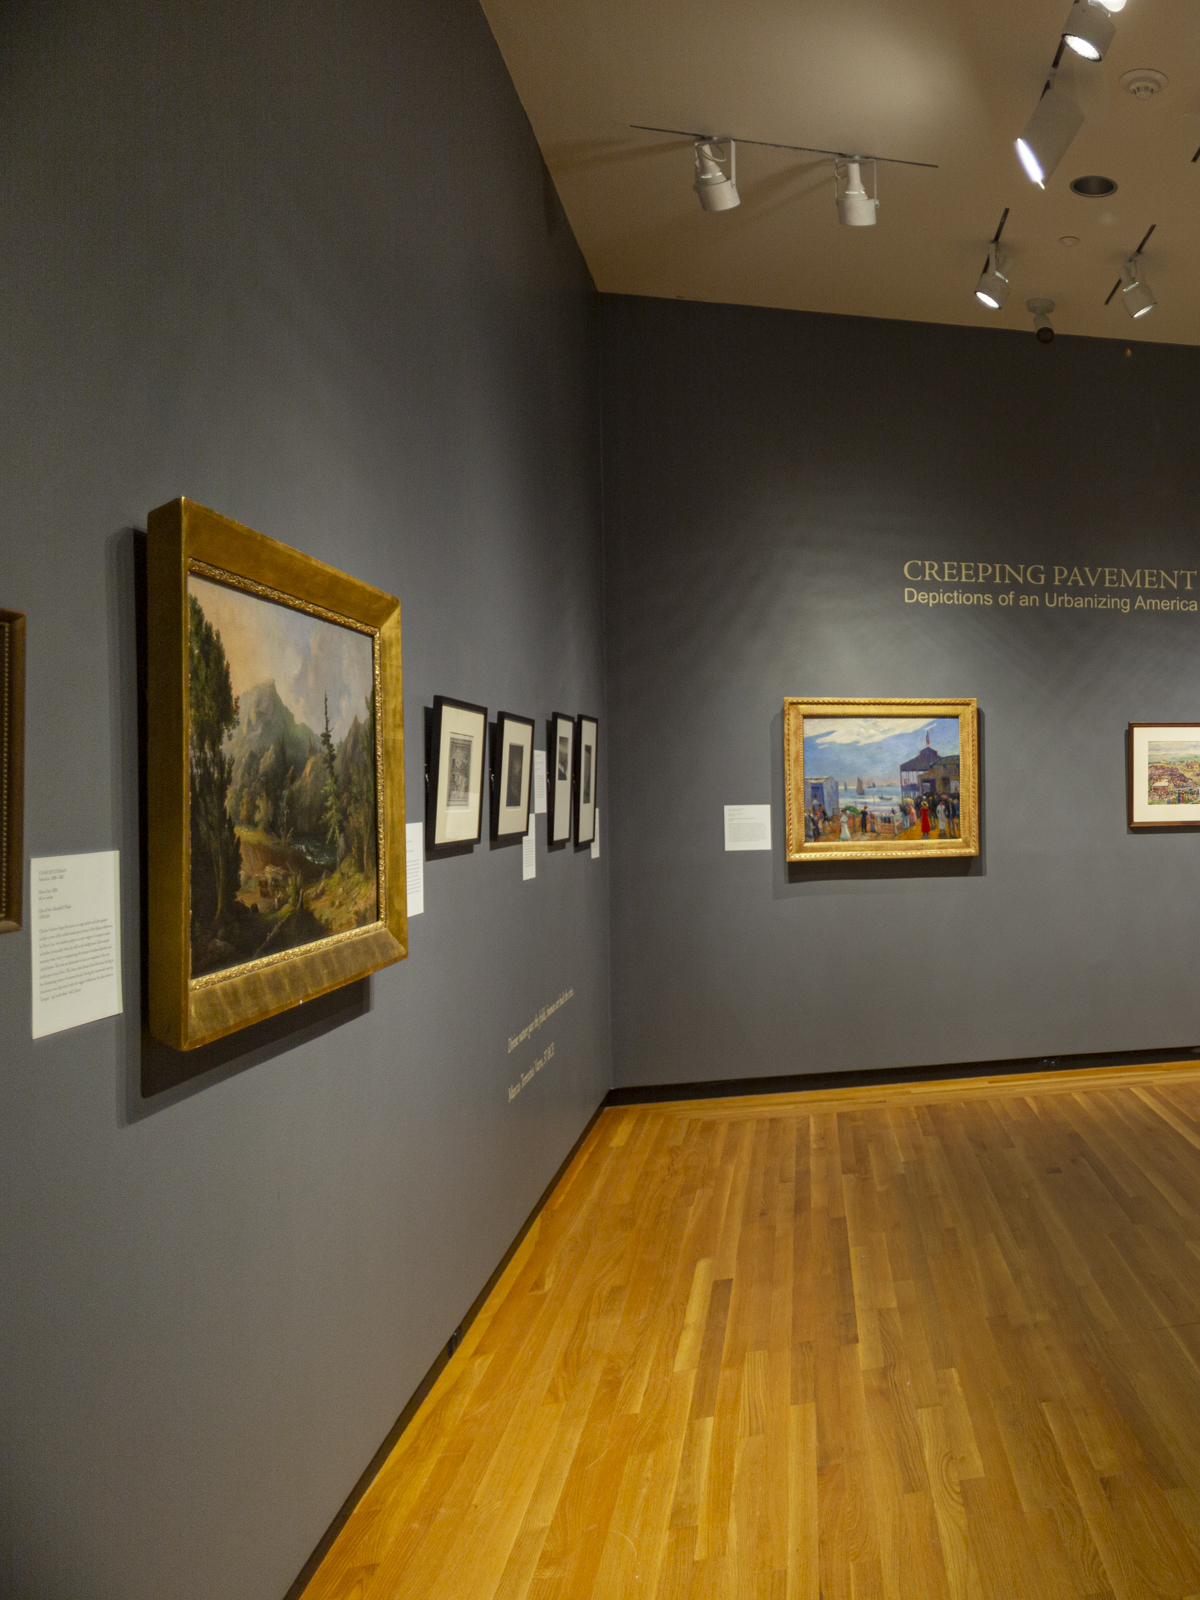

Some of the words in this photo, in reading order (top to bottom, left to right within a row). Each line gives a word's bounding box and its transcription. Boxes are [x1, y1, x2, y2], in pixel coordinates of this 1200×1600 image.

[903, 560, 1046, 585] CREEPING
[1053, 566, 1197, 590] PAVEMENT
[904, 587, 993, 607] Depictions
[998, 591, 1014, 606] of
[1019, 595, 1039, 607] an
[1045, 592, 1131, 613] Urbanizing
[1134, 595, 1198, 611] America
